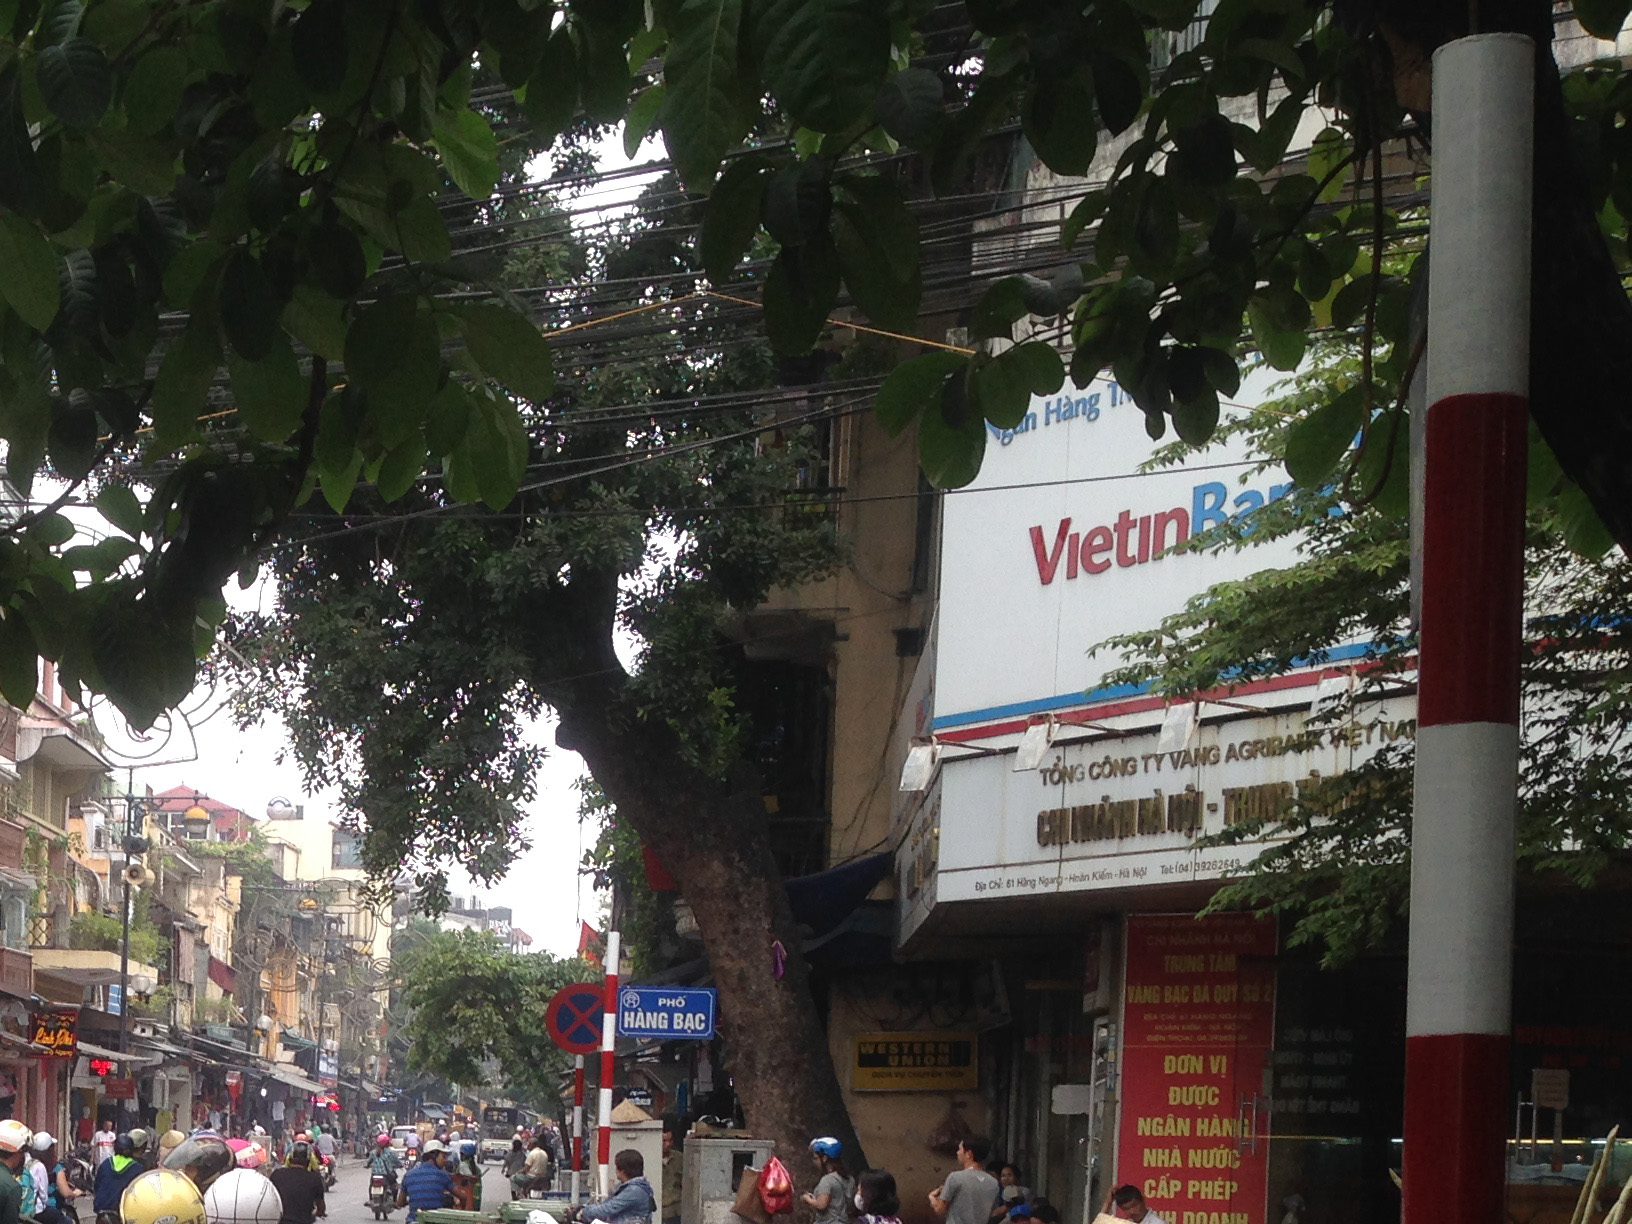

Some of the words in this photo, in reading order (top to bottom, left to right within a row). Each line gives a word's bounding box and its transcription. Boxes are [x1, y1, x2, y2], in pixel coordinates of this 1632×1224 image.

[1044, 392, 1100, 422] Hàng
[1040, 755, 1085, 787] TỔNG
[1088, 754, 1138, 780] CÔNG
[1141, 753, 1166, 774] TY
[658, 995, 686, 1008] PHỐ
[624, 1008, 668, 1030] HÀNG
[673, 1012, 705, 1034] BẠC
[859, 1042, 951, 1054] WESTERN
[888, 1054, 951, 1066] UNION
[1164, 1053, 1204, 1074] ĐƠN
[1209, 1055, 1227, 1079] VỊ
[1169, 1085, 1220, 1110] ĐƯỢC
[1137, 1114, 1191, 1137] NGÂN
[1196, 1115, 1250, 1138] HÀNG
[1143, 1145, 1182, 1168] NHÀ
[1188, 1144, 1241, 1169] NƯỚC
[1144, 1173, 1182, 1199] CẤP
[1187, 1176, 1238, 1200] PHÉP
